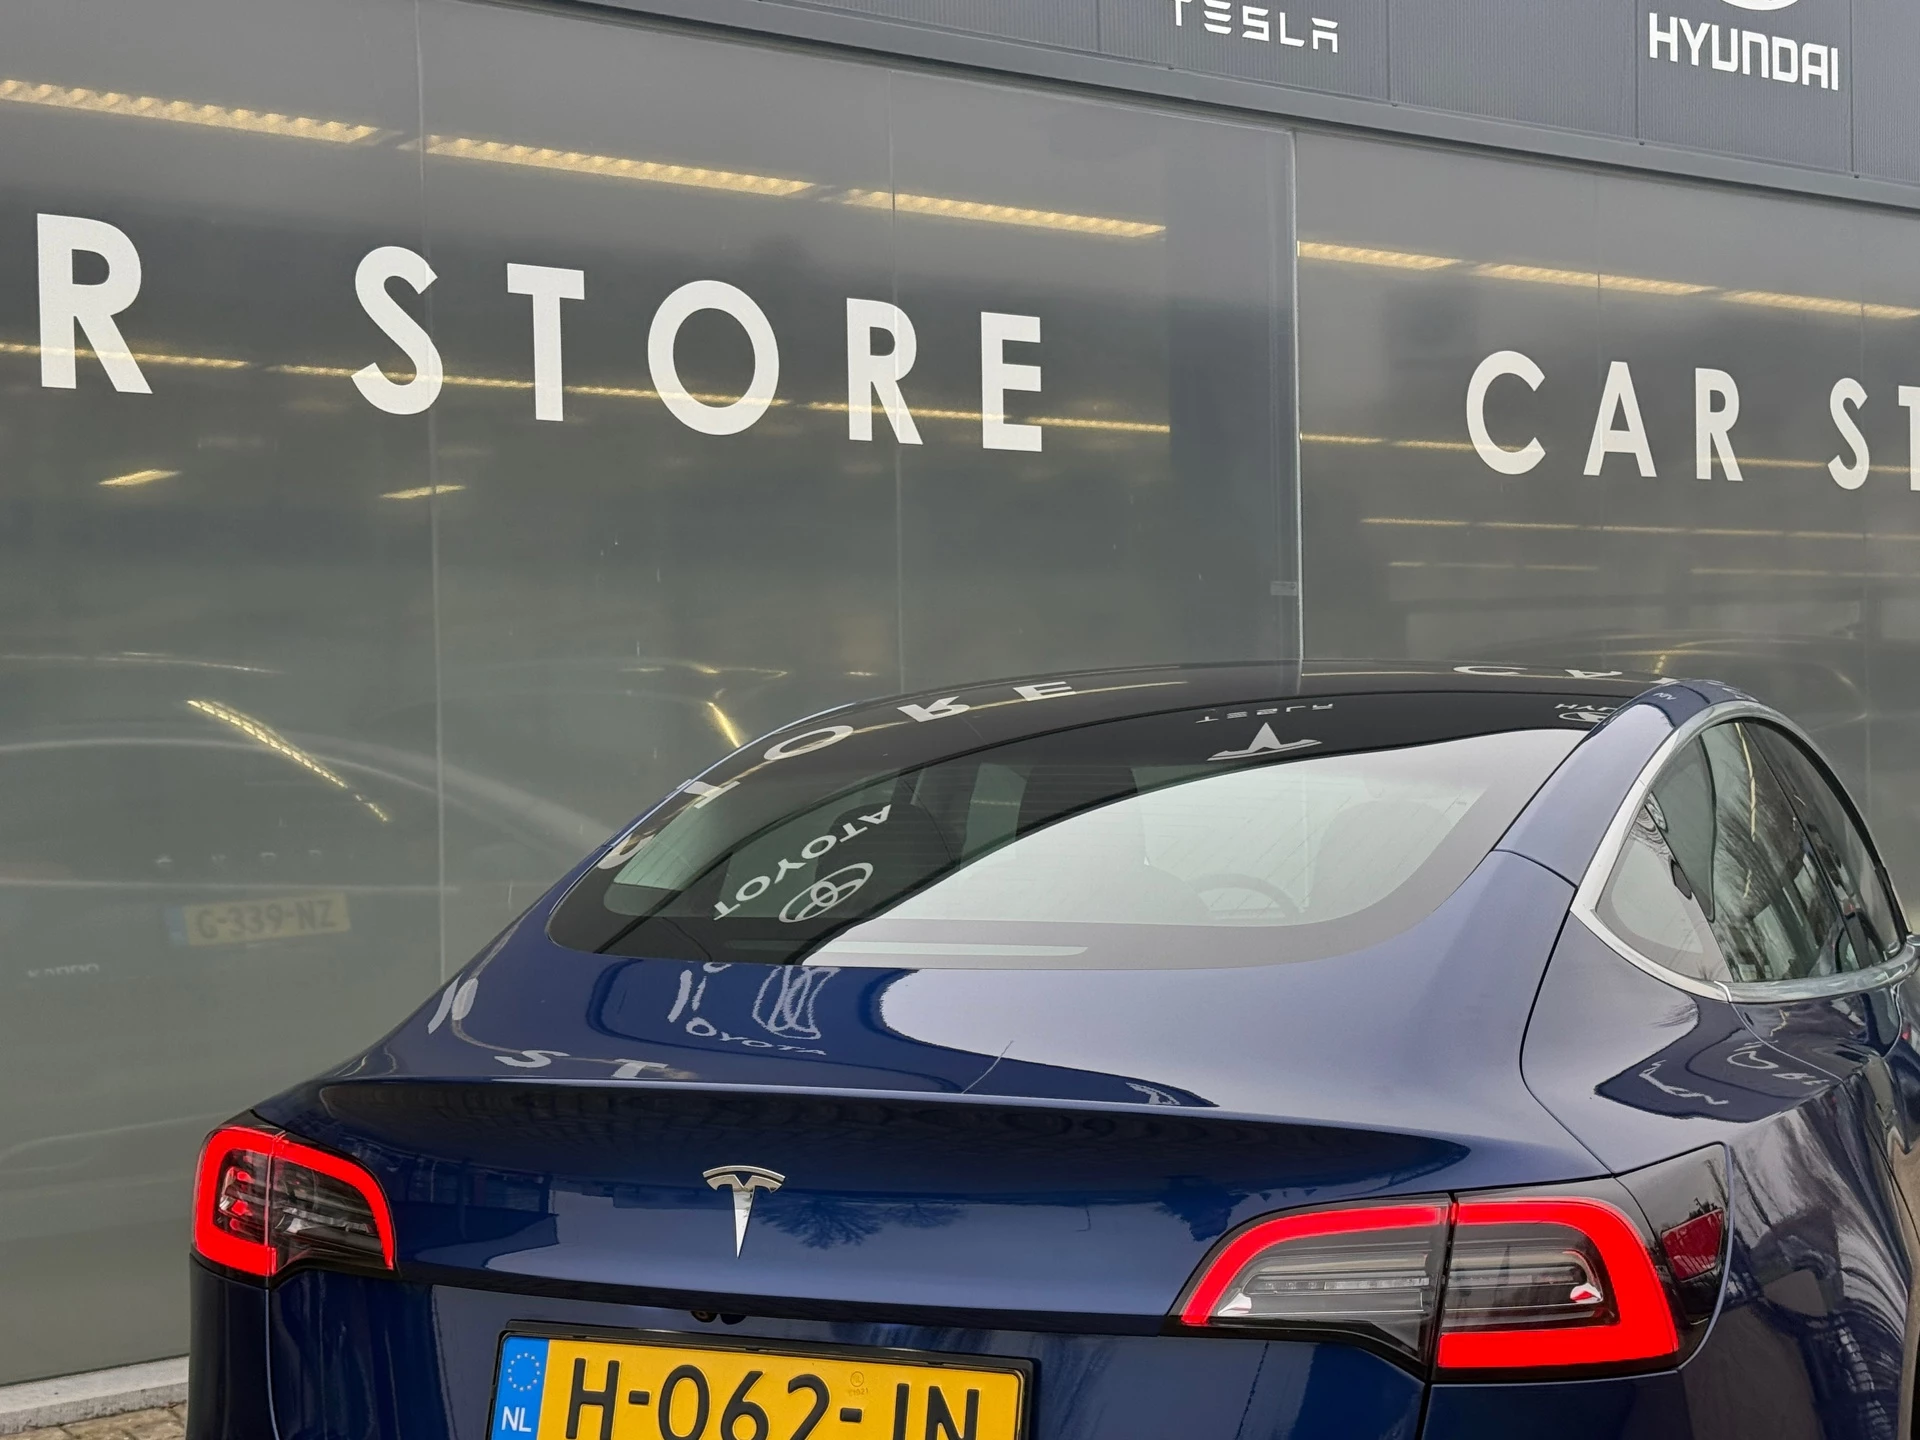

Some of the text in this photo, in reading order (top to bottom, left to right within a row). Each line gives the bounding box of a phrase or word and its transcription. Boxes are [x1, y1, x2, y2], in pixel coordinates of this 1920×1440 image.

[1174, 0, 1338, 54] TESLA
[1648, 12, 1839, 91] HYUNDAI
[37, 213, 1043, 453] R STORE
[1466, 350, 1743, 483] CAR
[502, 1407, 532, 1432] NL
